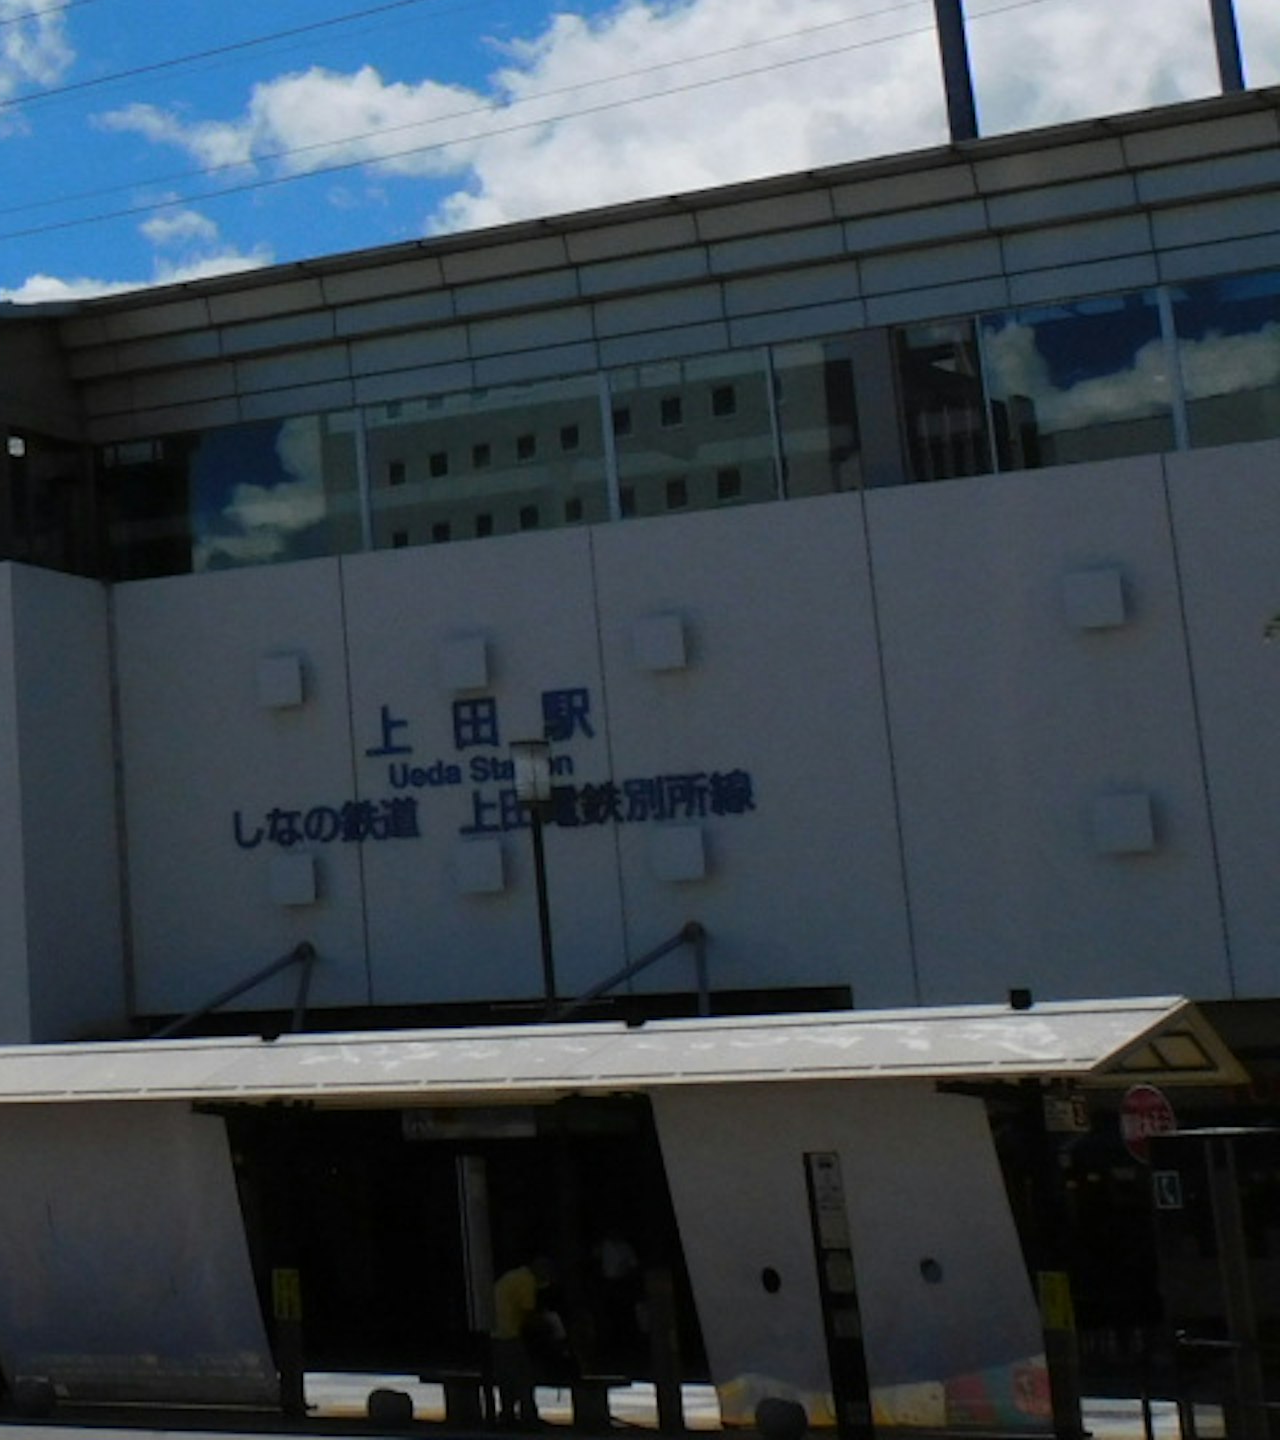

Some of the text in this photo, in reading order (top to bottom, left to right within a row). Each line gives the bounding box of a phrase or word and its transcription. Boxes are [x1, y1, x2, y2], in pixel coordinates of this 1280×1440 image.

[389, 759, 462, 789] Ueda
[234, 796, 420, 849] しなの鉄道
